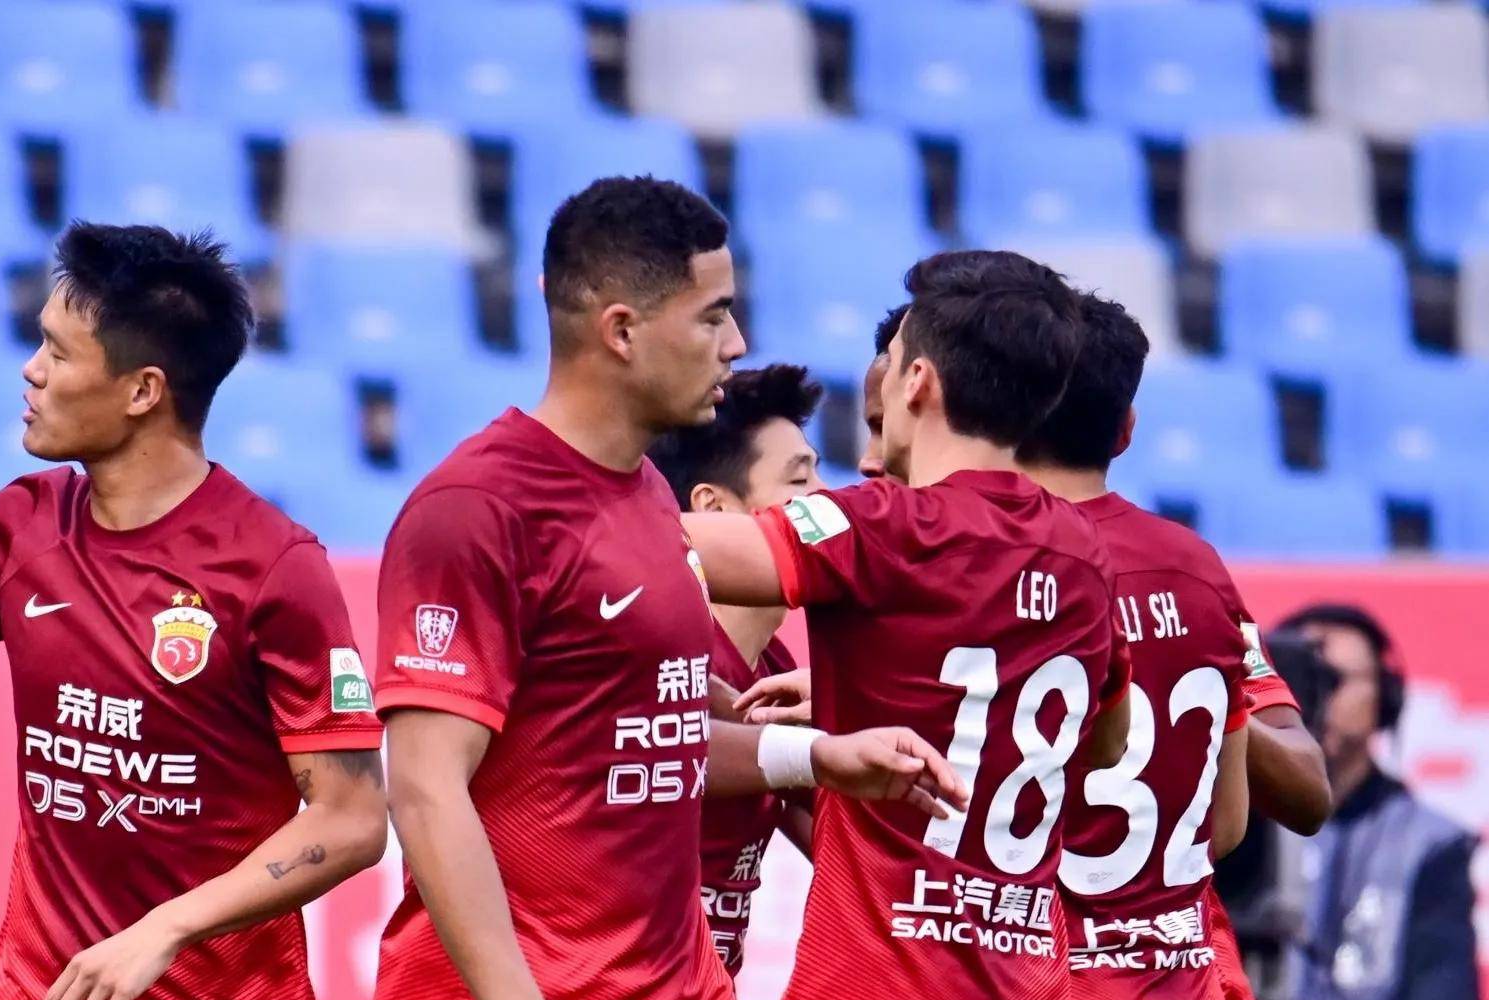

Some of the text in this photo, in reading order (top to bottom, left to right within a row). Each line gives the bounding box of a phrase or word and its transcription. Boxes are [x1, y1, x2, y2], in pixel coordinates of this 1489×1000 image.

[1016, 570, 1058, 622] LEO
[1117, 591, 1189, 643] LI SH.
[394, 655, 466, 677] ROEWE
[56, 683, 144, 742] 荣威
[25, 725, 197, 785] ROEWE
[924, 646, 1090, 876] 18
[1058, 666, 1229, 896] 32
[890, 916, 1058, 959] SAIC MOTOR
[1068, 951, 1147, 971] SAIC
